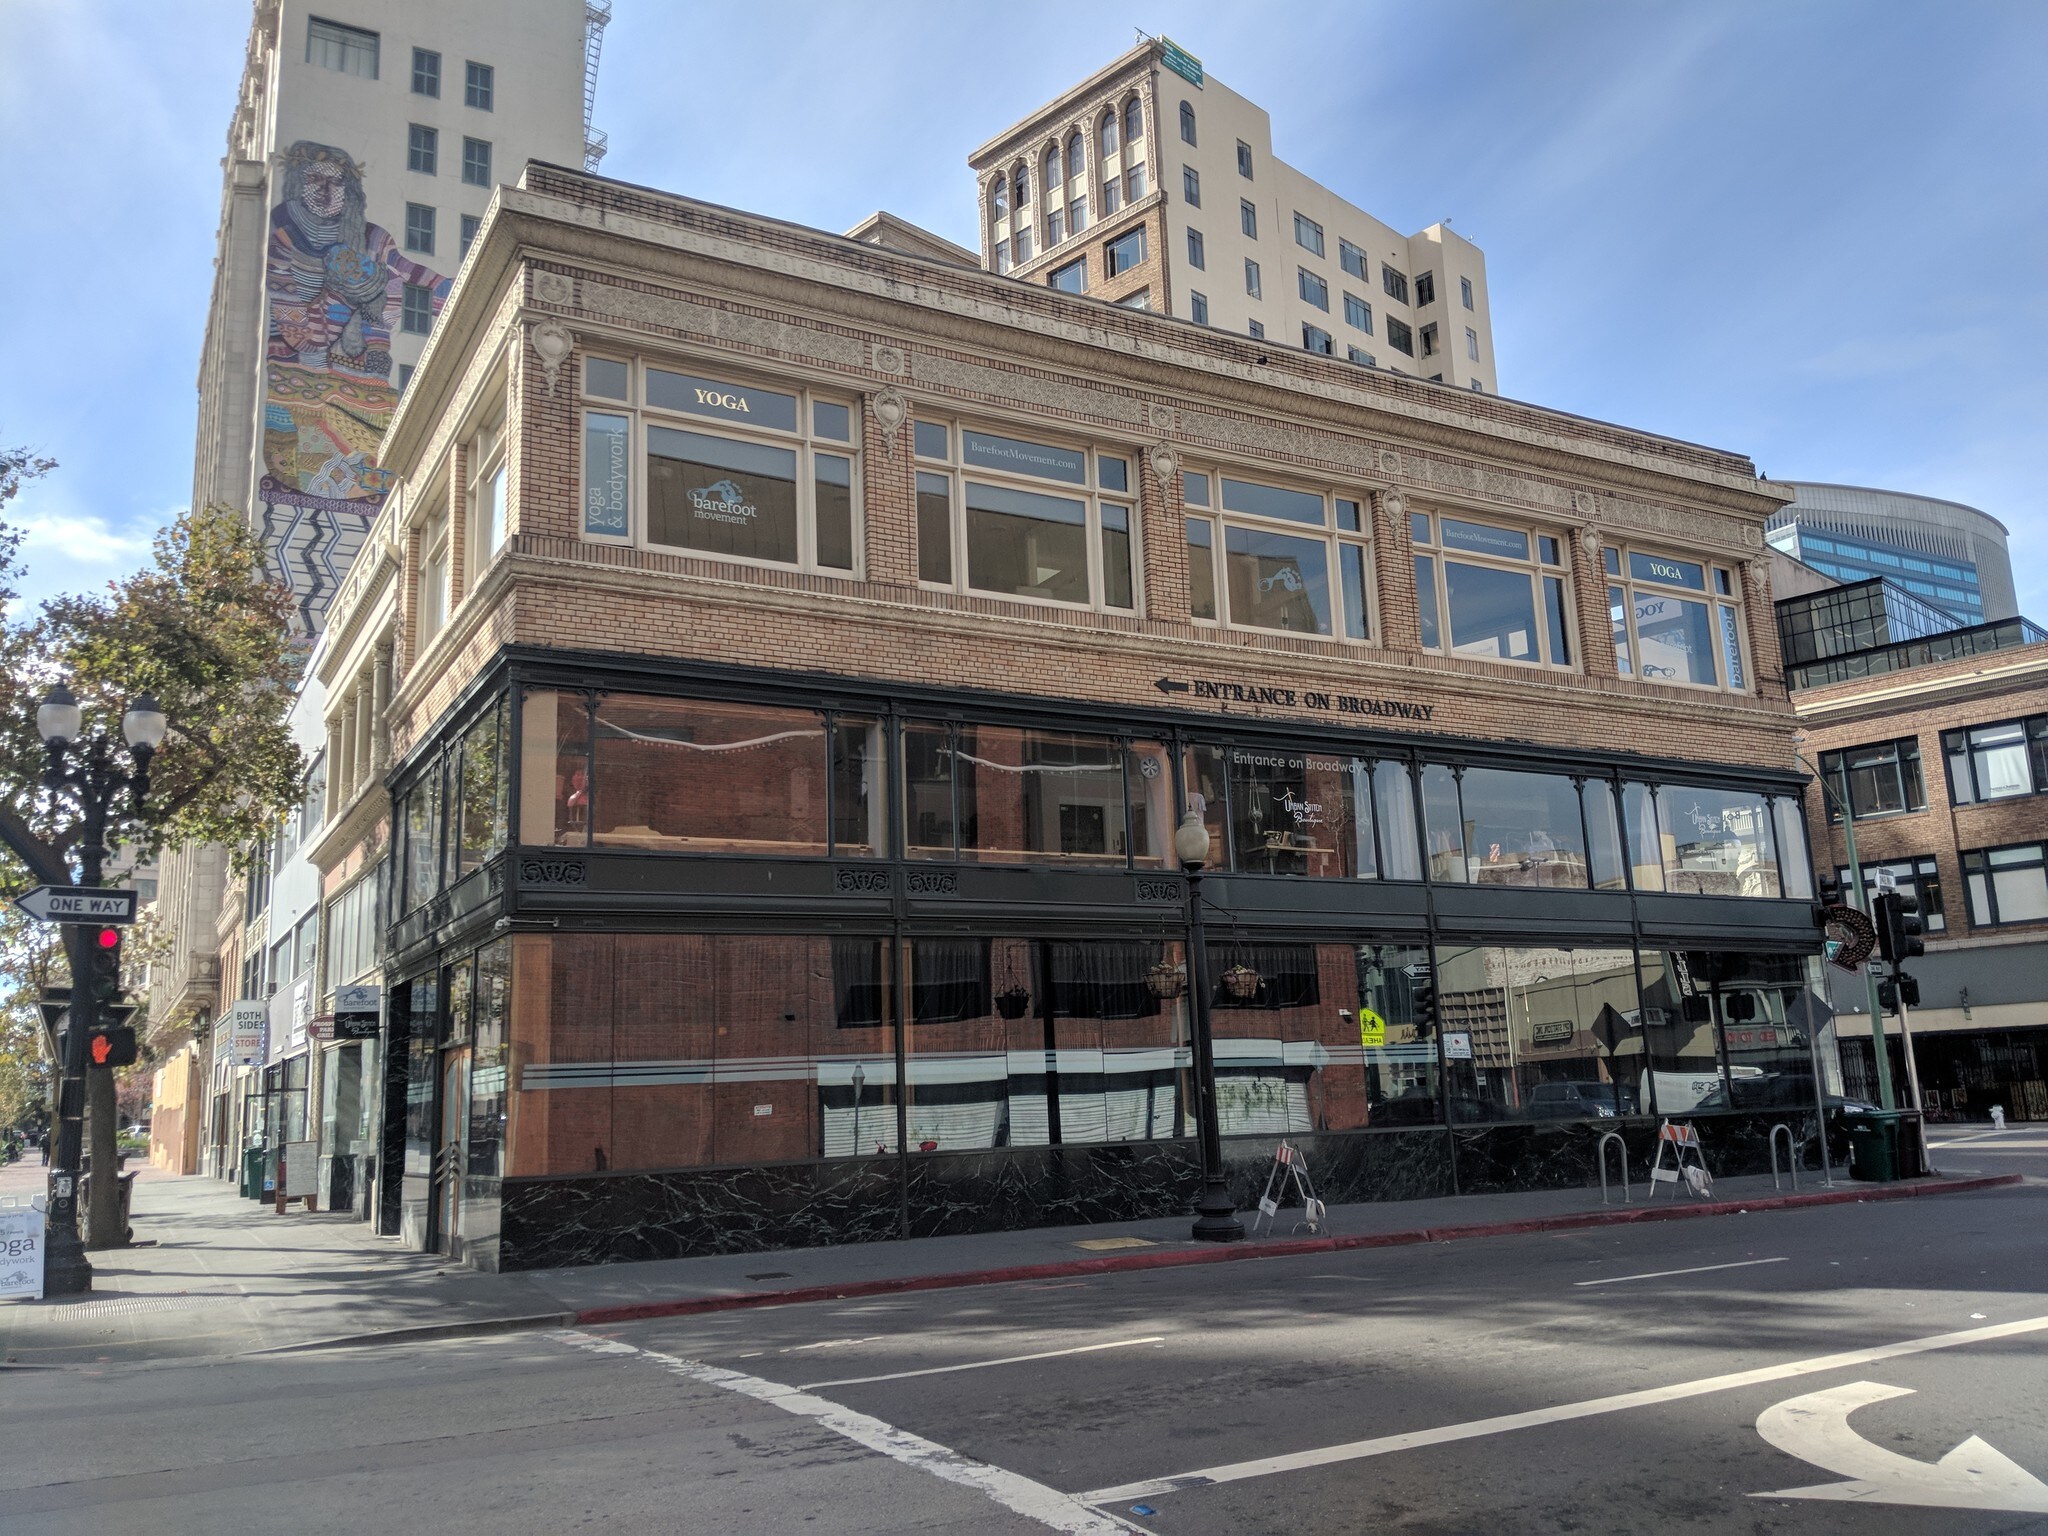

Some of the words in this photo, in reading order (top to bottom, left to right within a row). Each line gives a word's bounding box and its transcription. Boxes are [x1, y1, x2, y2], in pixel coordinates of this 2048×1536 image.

[694, 388, 750, 413] YOGA
[971, 441, 1077, 470] BarefootMovement.com
[606, 428, 627, 510] bodywork
[588, 486, 606, 526] yoga
[693, 494, 757, 518] barefoot
[607, 516, 623, 529] &
[694, 509, 748, 526] movement
[1445, 528, 1523, 550] BarefootMovement.com
[1650, 562, 1682, 580] YOGA
[1725, 613, 1742, 684] barefoot
[1193, 680, 1296, 707] ENTRANCE
[1304, 691, 1331, 710] ON
[1337, 695, 1435, 721] BROADWAY
[1233, 751, 1285, 768] Entrance
[1289, 759, 1304, 769] on
[1306, 759, 1363, 775] Broadway
[50, 897, 83, 912] ONE
[90, 900, 124, 913] WAY
[344, 998, 377, 1007] barefoot
[237, 1011, 262, 1020] BOTH
[238, 1020, 265, 1030] SIDES
[235, 1039, 260, 1048] STORE
